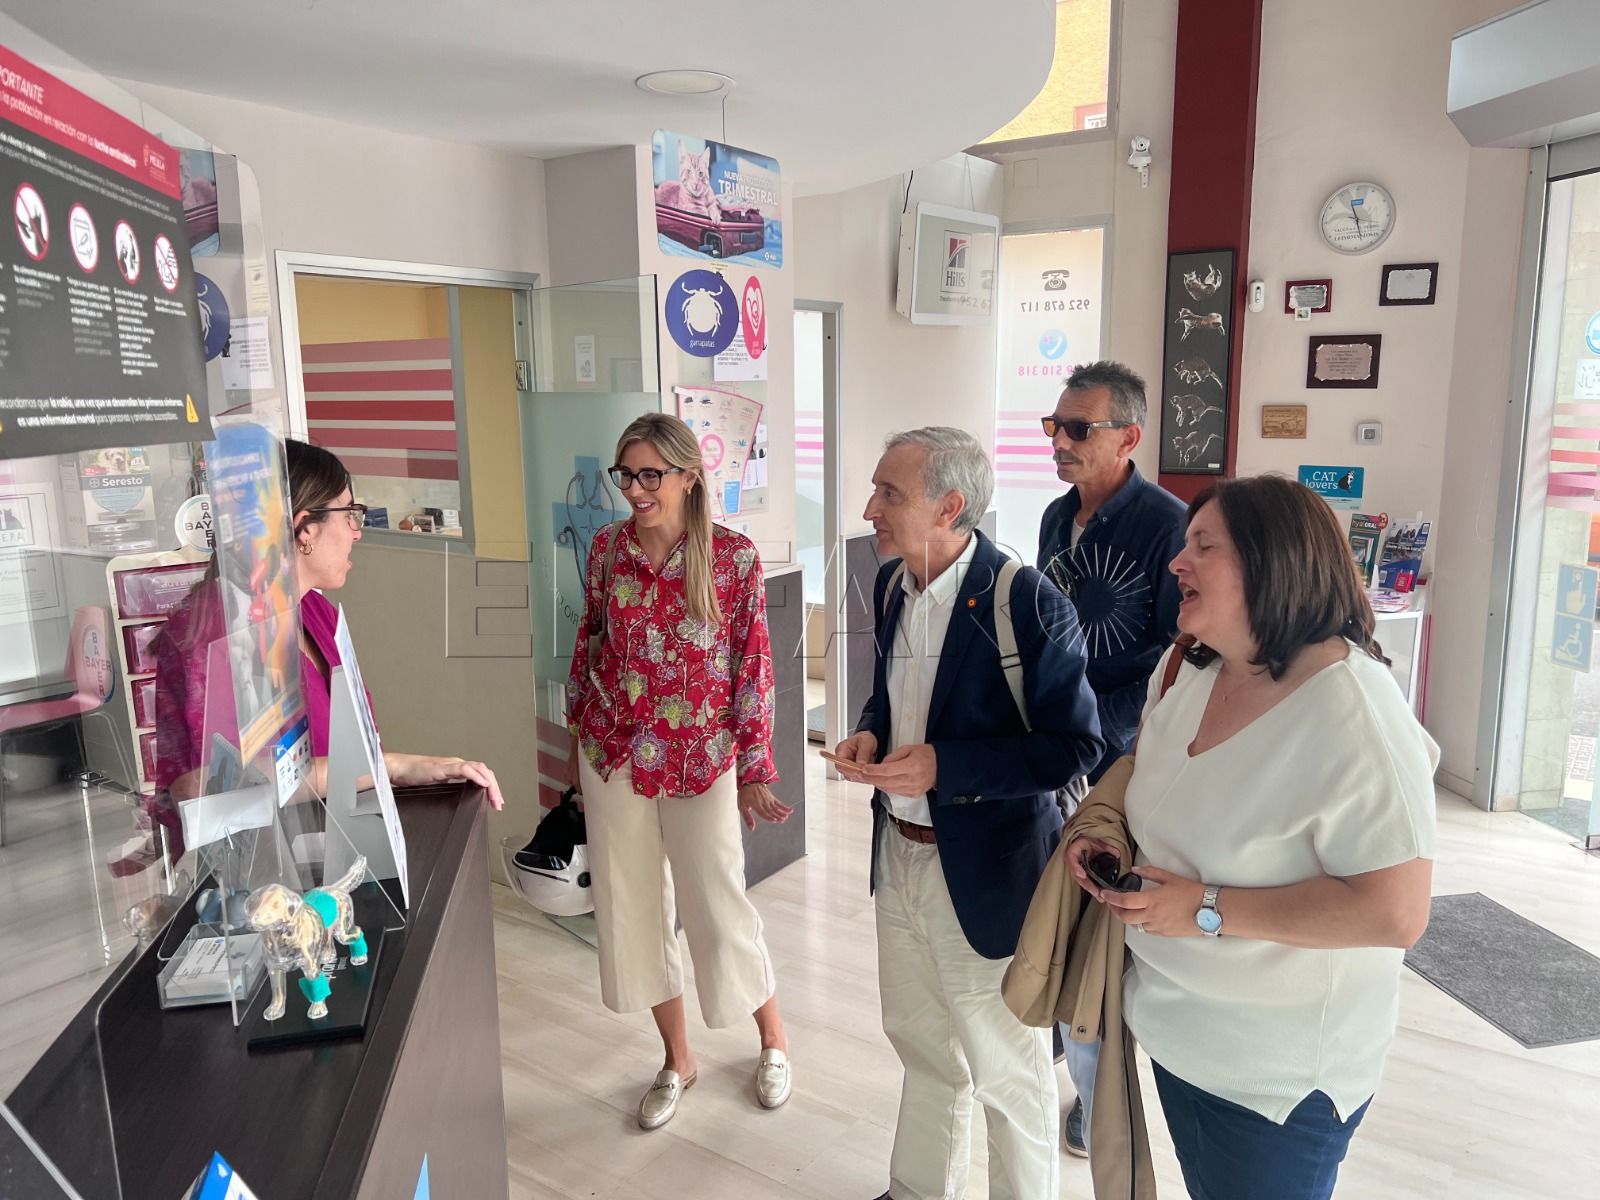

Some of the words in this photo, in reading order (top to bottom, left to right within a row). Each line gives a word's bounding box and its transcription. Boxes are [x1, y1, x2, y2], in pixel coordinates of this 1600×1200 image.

[718, 179, 778, 205] TRIMESTRAL
[102, 476, 143, 487] Seresto
[1312, 471, 1337, 482] CAT
[1305, 478, 1338, 489] lovers
